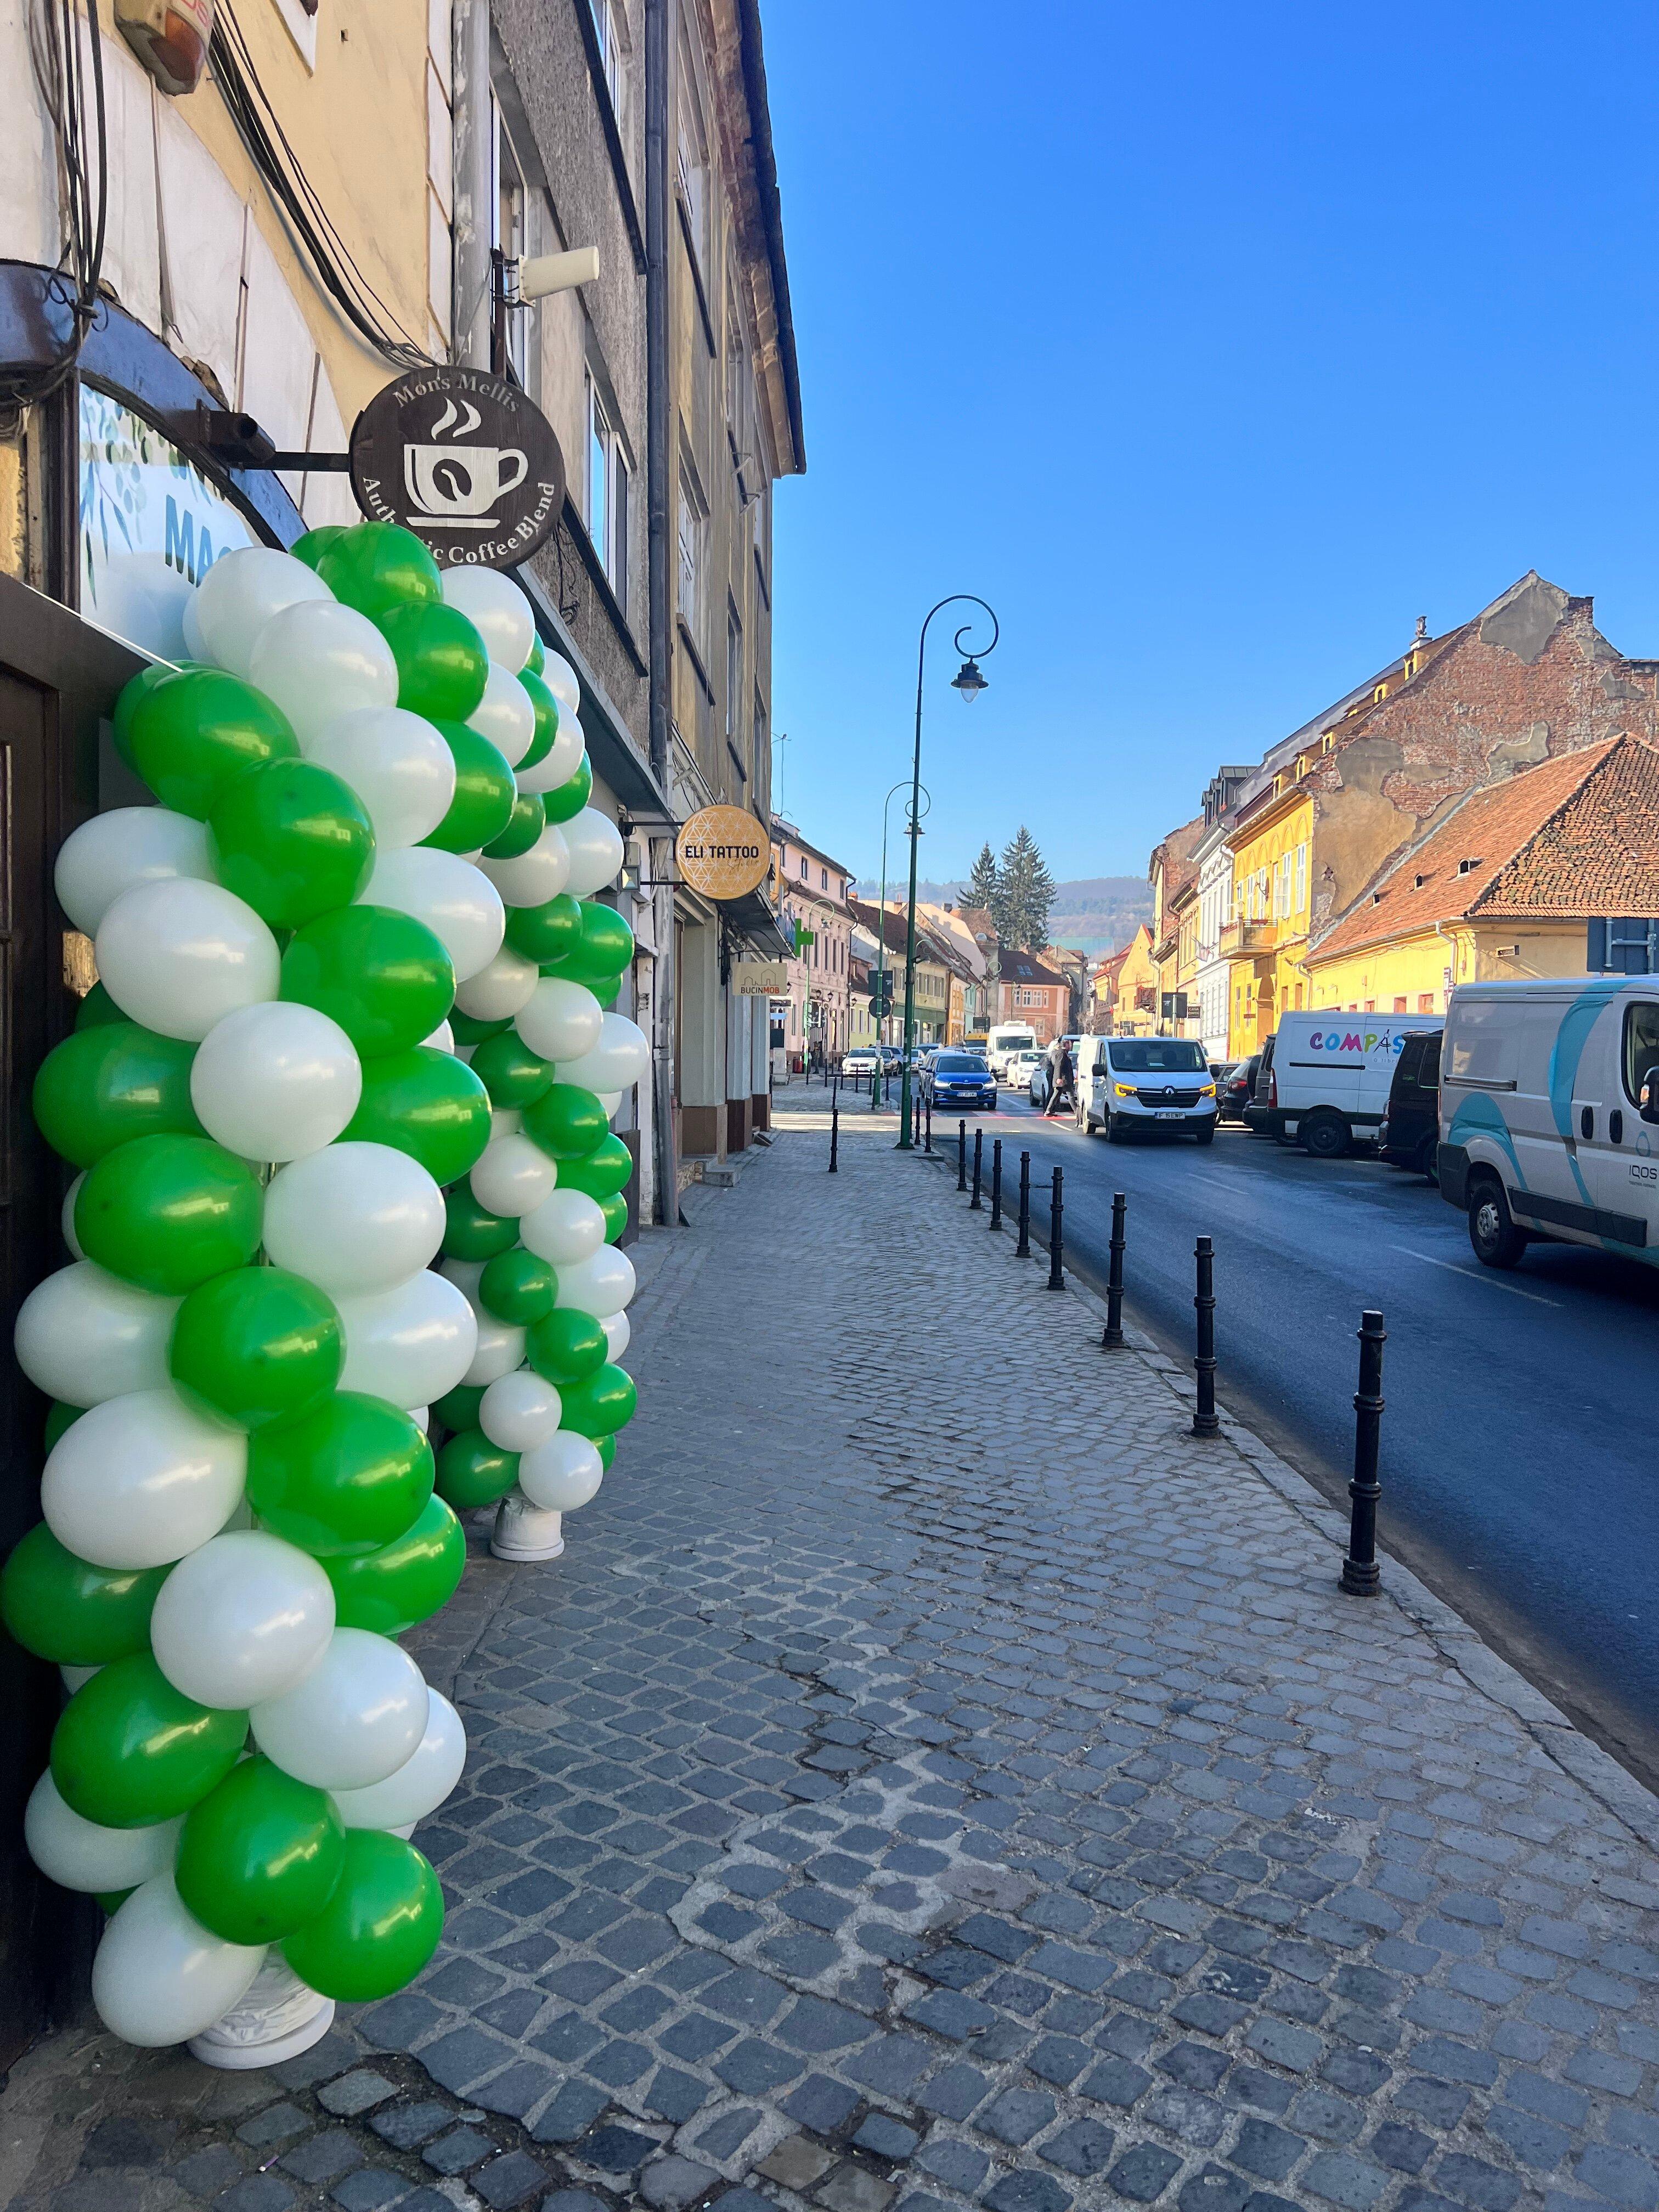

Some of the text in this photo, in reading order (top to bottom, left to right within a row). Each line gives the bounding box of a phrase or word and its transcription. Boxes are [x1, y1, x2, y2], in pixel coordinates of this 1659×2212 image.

[392, 374, 518, 412] Mons Mellis
[165, 494, 233, 588] MA
[448, 537, 519, 563] Coffee
[515, 482, 555, 540] Blend
[686, 845, 759, 859] ELI TATTOO
[1629, 1165, 1657, 1180] IQOS
